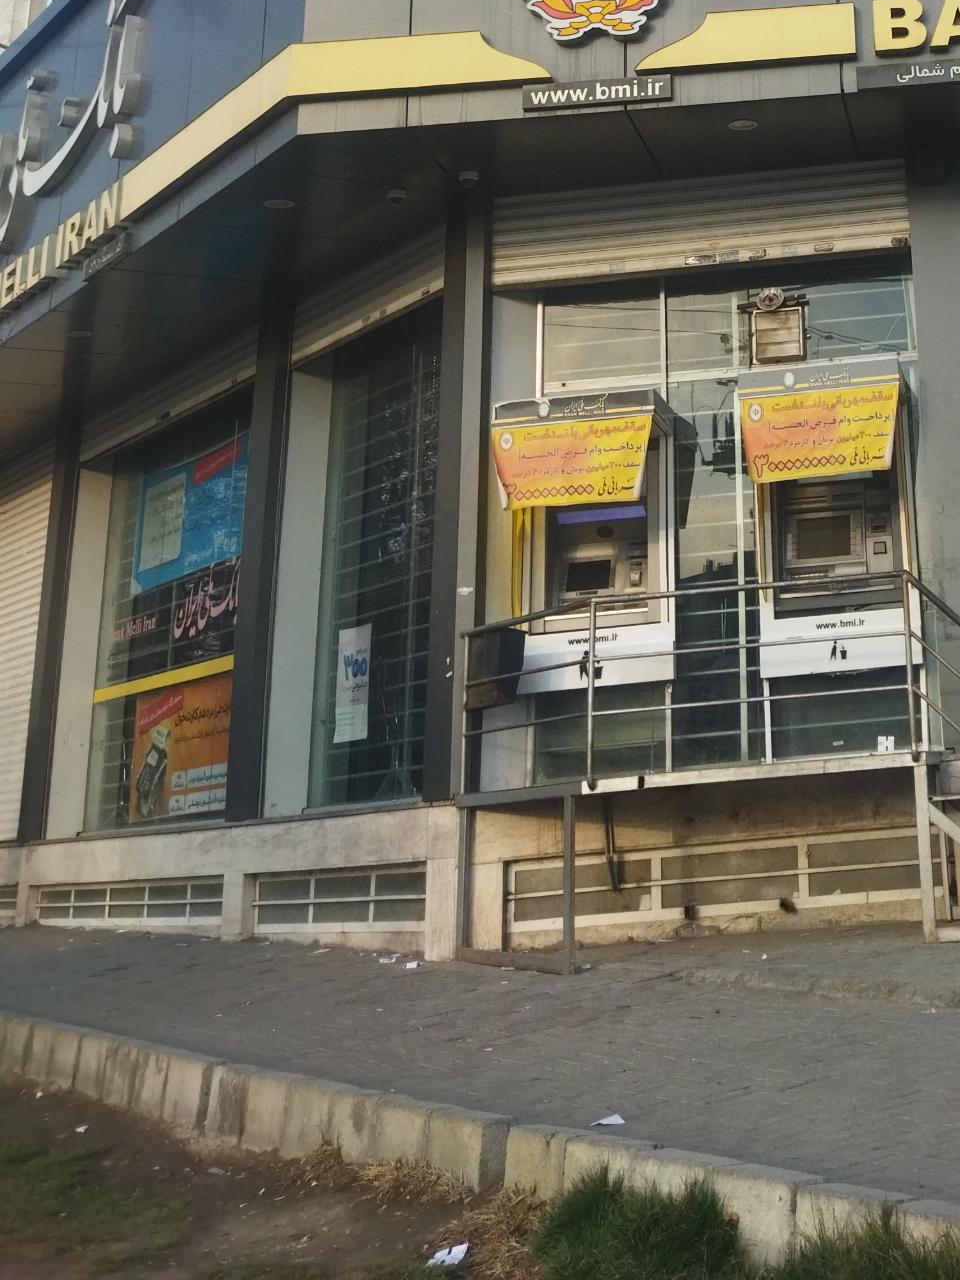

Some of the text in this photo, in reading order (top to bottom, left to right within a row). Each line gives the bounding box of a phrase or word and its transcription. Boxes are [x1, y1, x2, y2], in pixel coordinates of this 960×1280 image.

[896, 63, 945, 83] شمالی
[530, 79, 664, 105] www.bmi.ir
[0, 180, 119, 309] ELLI IRAN
[815, 618, 866, 630] www.bmi.ir
